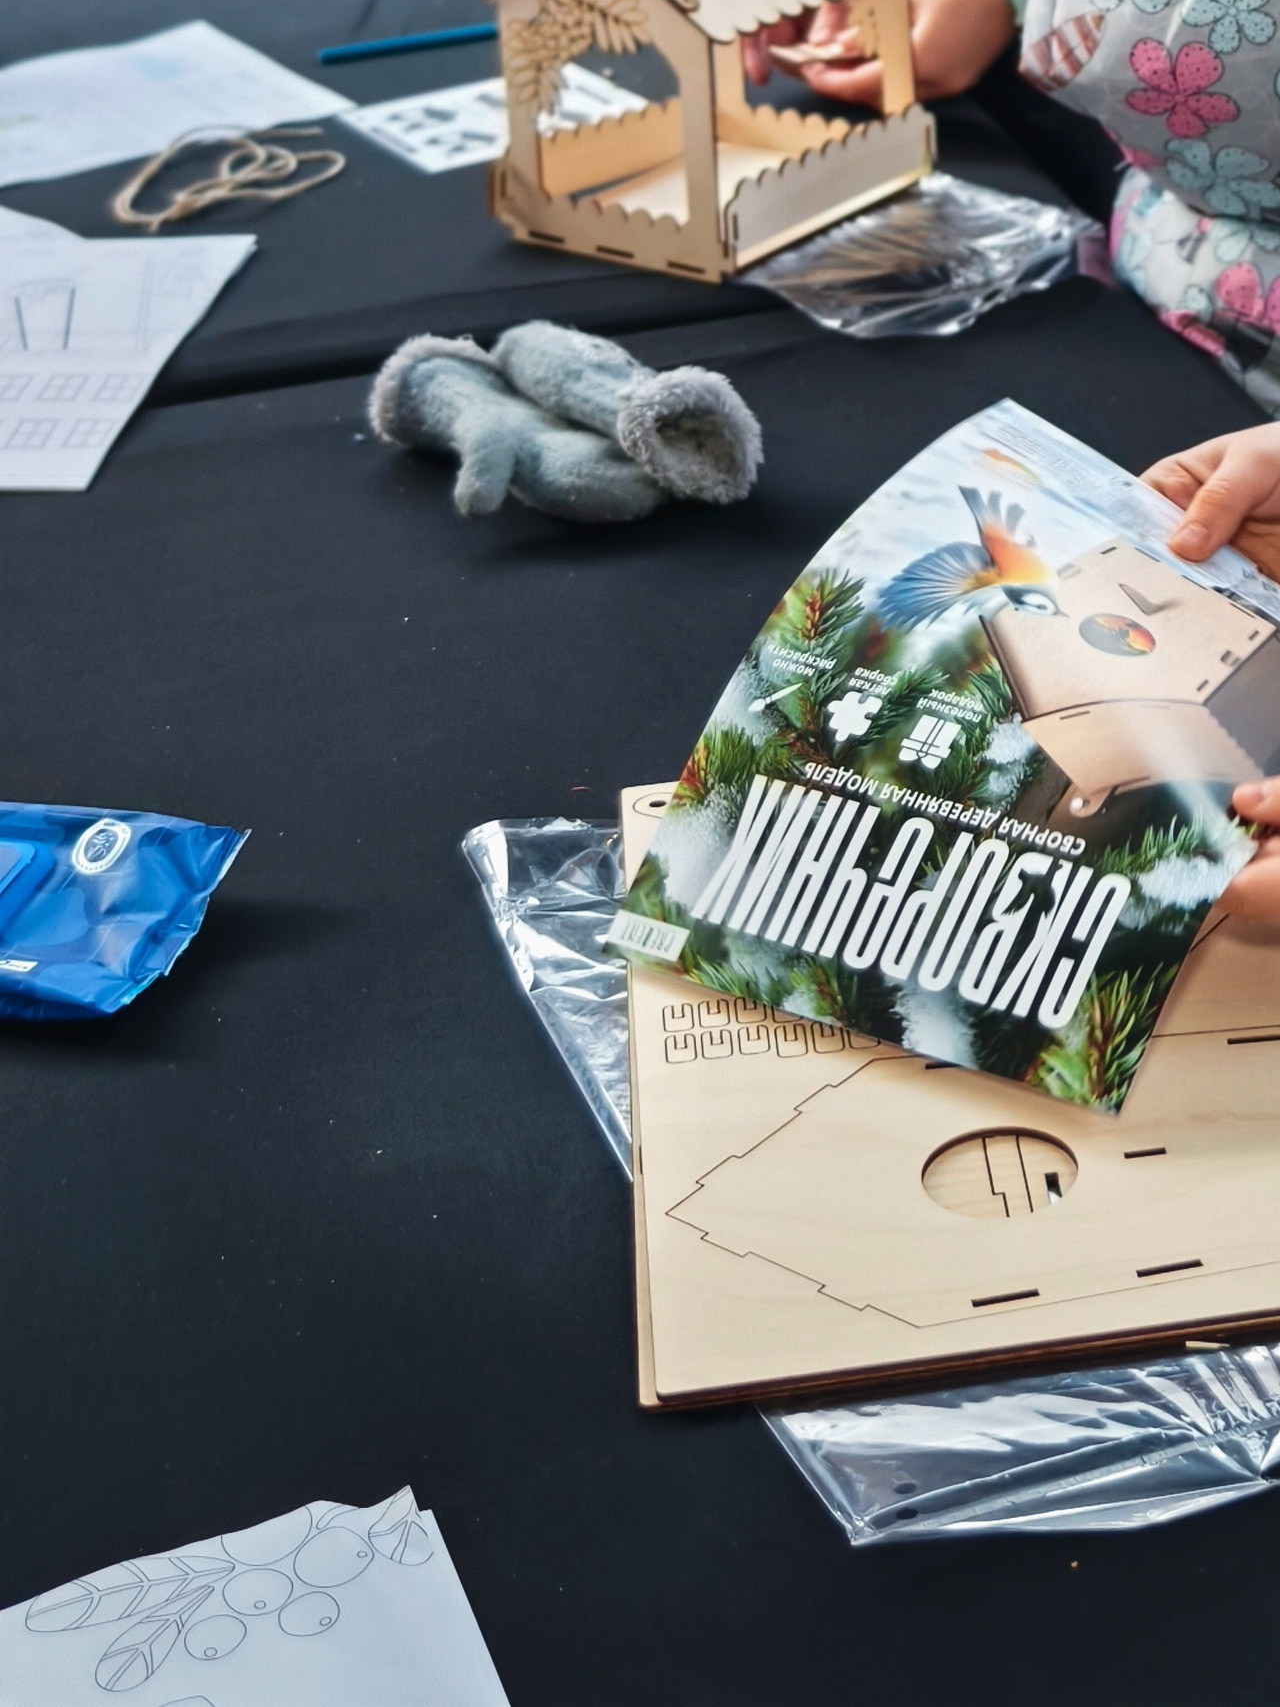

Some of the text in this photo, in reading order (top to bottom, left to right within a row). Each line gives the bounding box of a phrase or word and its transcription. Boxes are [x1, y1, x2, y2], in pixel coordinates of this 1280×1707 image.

[764, 645, 838, 670] раскрасить
[772, 658, 815, 677] можно
[855, 666, 898, 686] сборка
[917, 696, 983, 723] полезный
[929, 688, 984, 713] подарок
[804, 761, 1086, 856] СБОРНАЯ ДЕРЕВЯННАЯ МОДЕЛЬ
